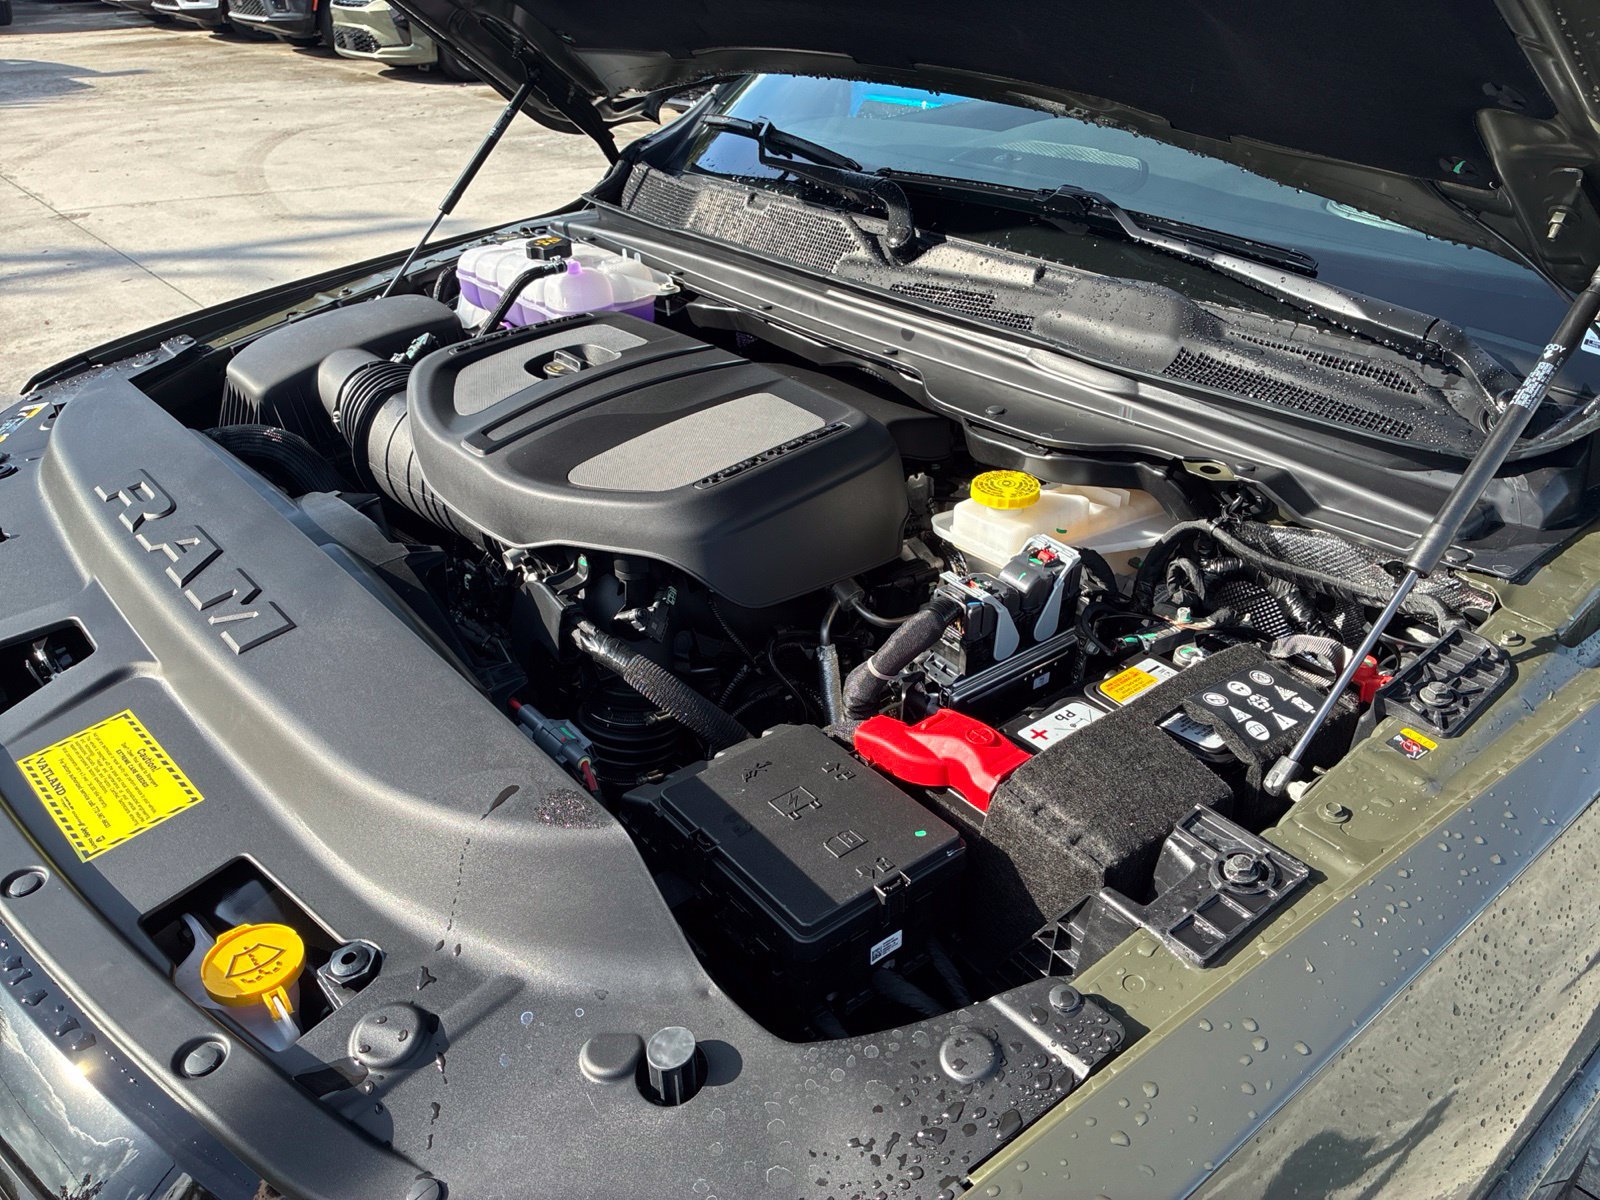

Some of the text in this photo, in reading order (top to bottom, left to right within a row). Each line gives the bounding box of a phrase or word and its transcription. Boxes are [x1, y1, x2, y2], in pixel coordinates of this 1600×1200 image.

[94, 468, 297, 655] RAM
[1054, 709, 1076, 722] Pb
[35, 756, 66, 796] VATLAND
[136, 748, 161, 772] Caution!
